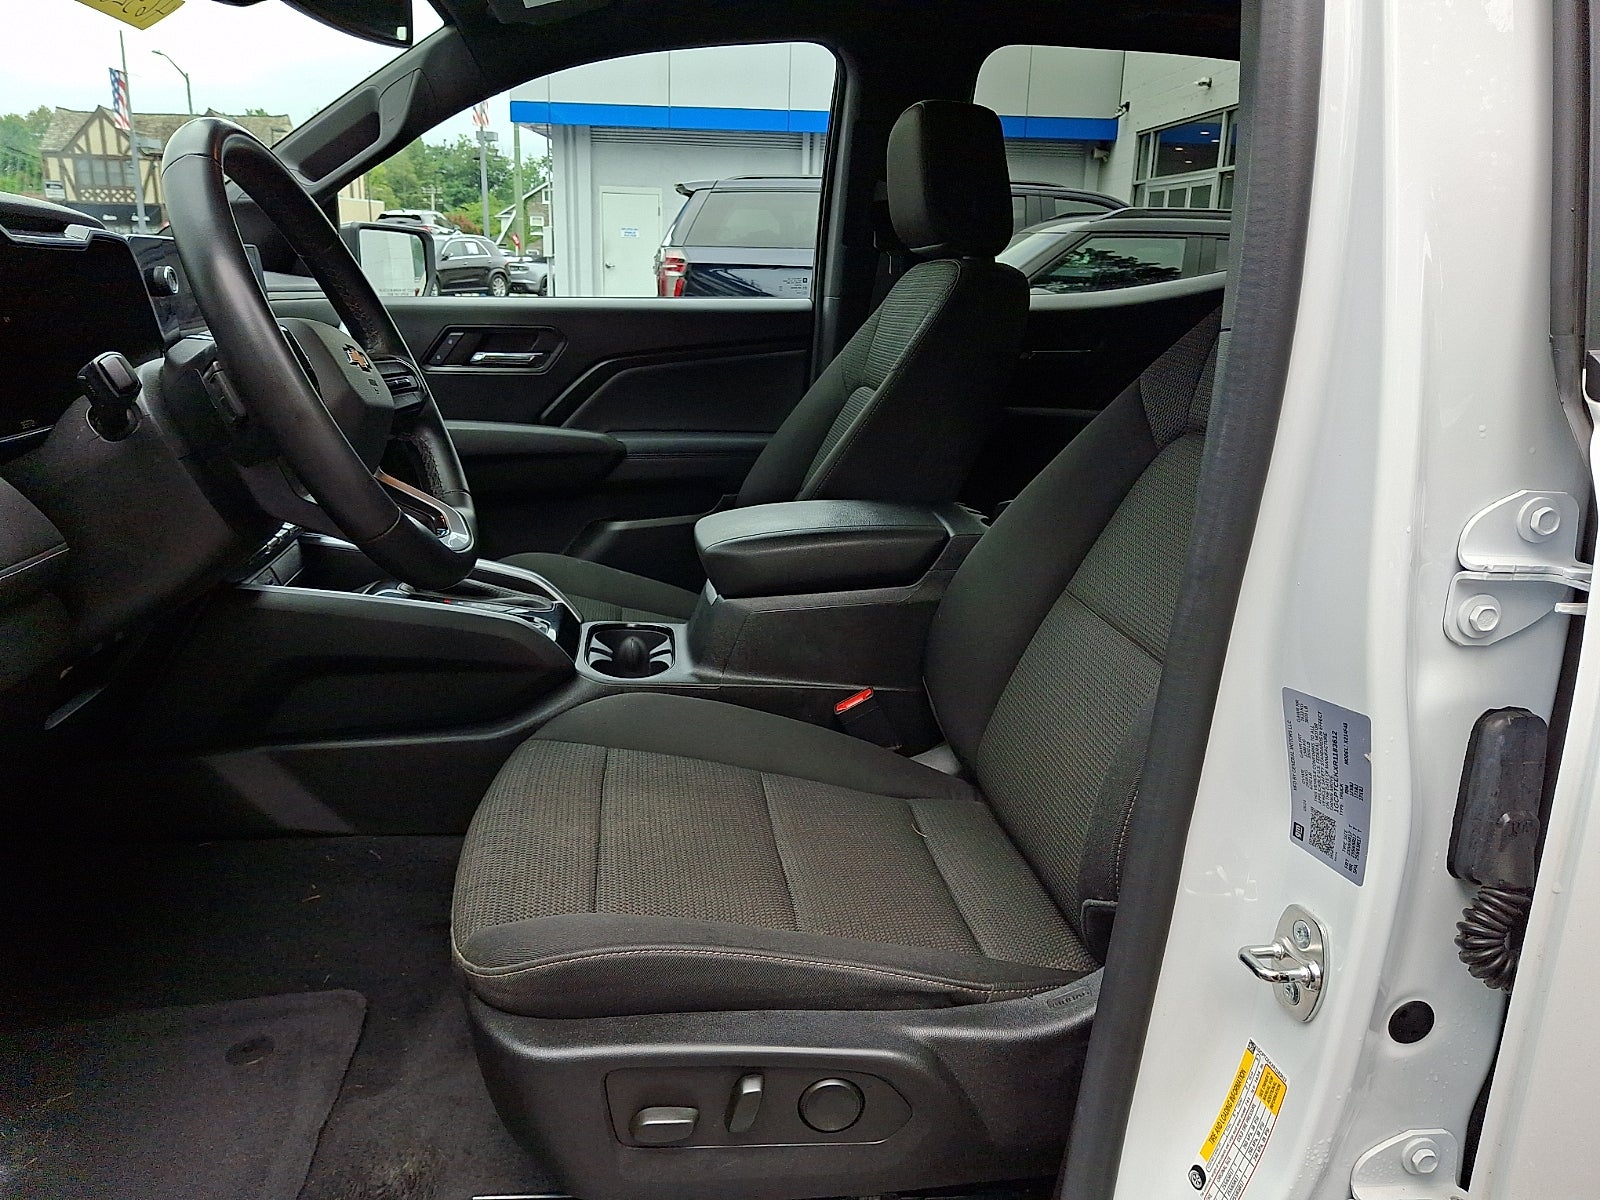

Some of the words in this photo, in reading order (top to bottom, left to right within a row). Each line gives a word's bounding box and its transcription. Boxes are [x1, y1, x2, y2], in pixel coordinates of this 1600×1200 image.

[1208, 1131, 1218, 1145] TIRE
[1214, 1121, 1223, 1135] AND
[1219, 1099, 1233, 1124] LOADING
[1229, 1067, 1247, 1103] INFORMATION
[1245, 1103, 1256, 1124] PRESSURE
